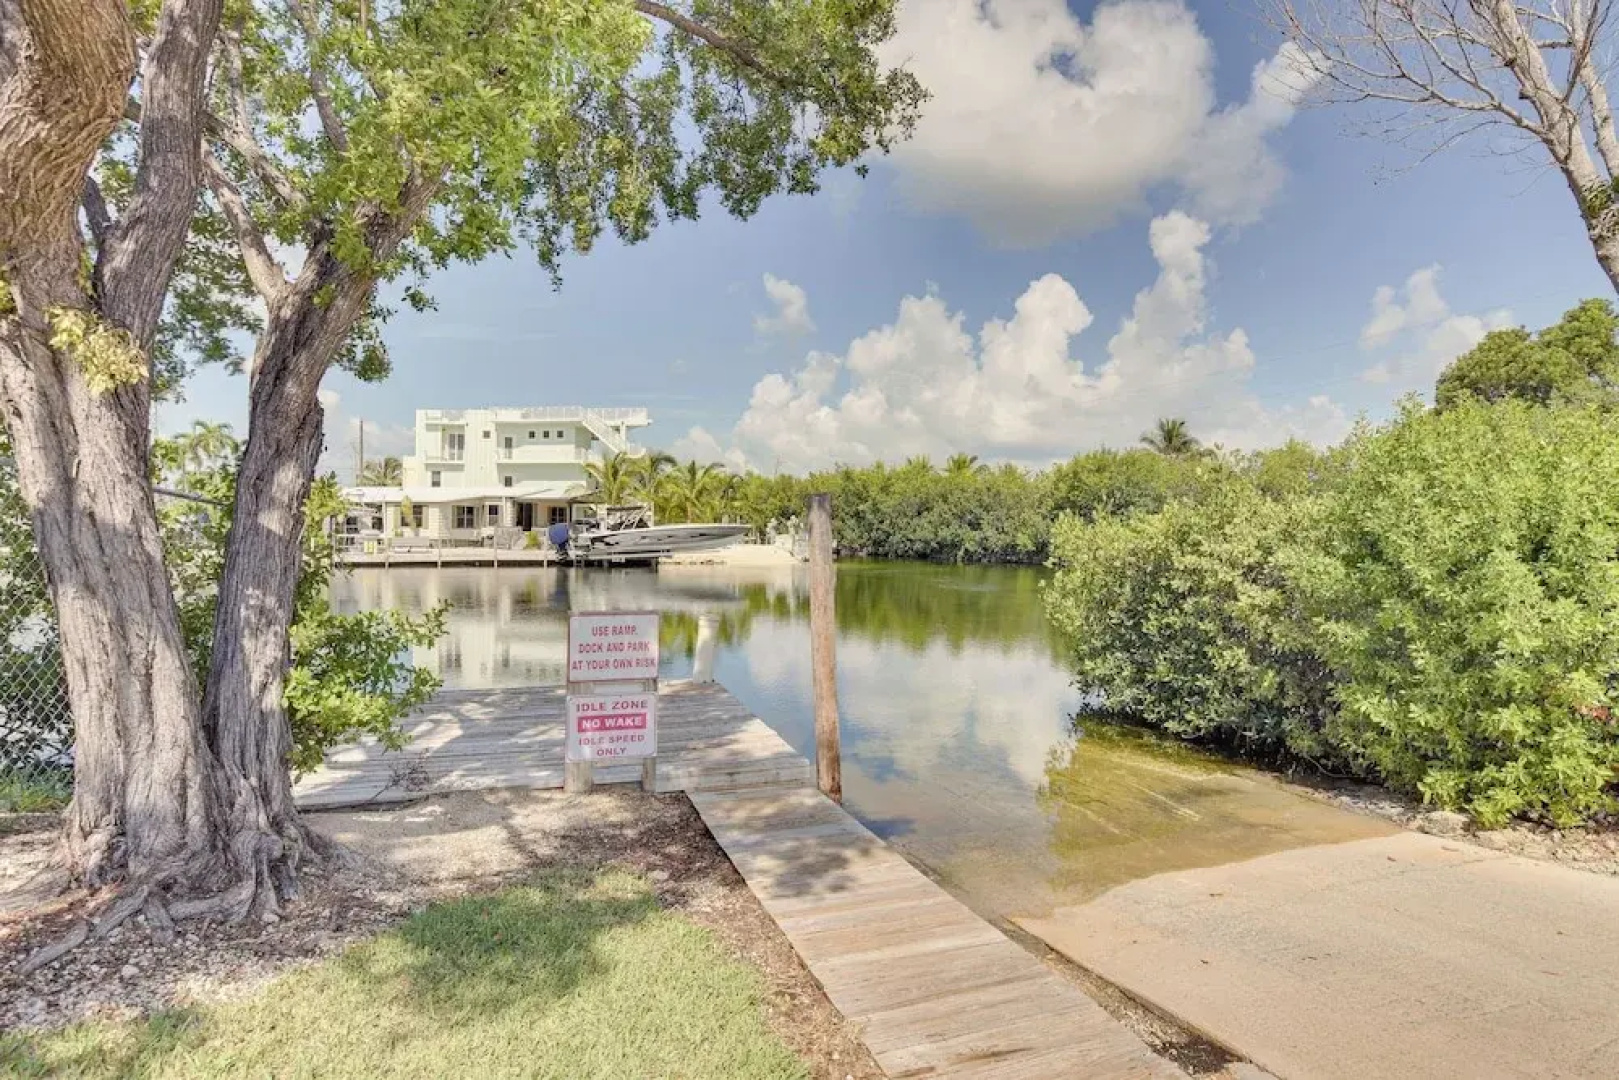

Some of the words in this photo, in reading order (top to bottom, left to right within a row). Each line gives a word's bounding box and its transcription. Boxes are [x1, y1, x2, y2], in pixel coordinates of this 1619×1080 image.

[592, 626, 609, 636] USE
[578, 643, 603, 653] DOCK
[607, 642, 625, 651] AND
[627, 641, 650, 650] PARK
[572, 660, 583, 670] AT
[586, 659, 610, 670] YOUR
[613, 659, 632, 668] OWN
[636, 657, 655, 667] RISK
[576, 702, 607, 712] IDLE
[612, 700, 648, 710] ZONE
[582, 719, 600, 728] NO
[604, 716, 642, 727] WAKE
[579, 737, 604, 745] IDLE
[609, 734, 644, 744] SPEED
[597, 747, 627, 756] ONLY
